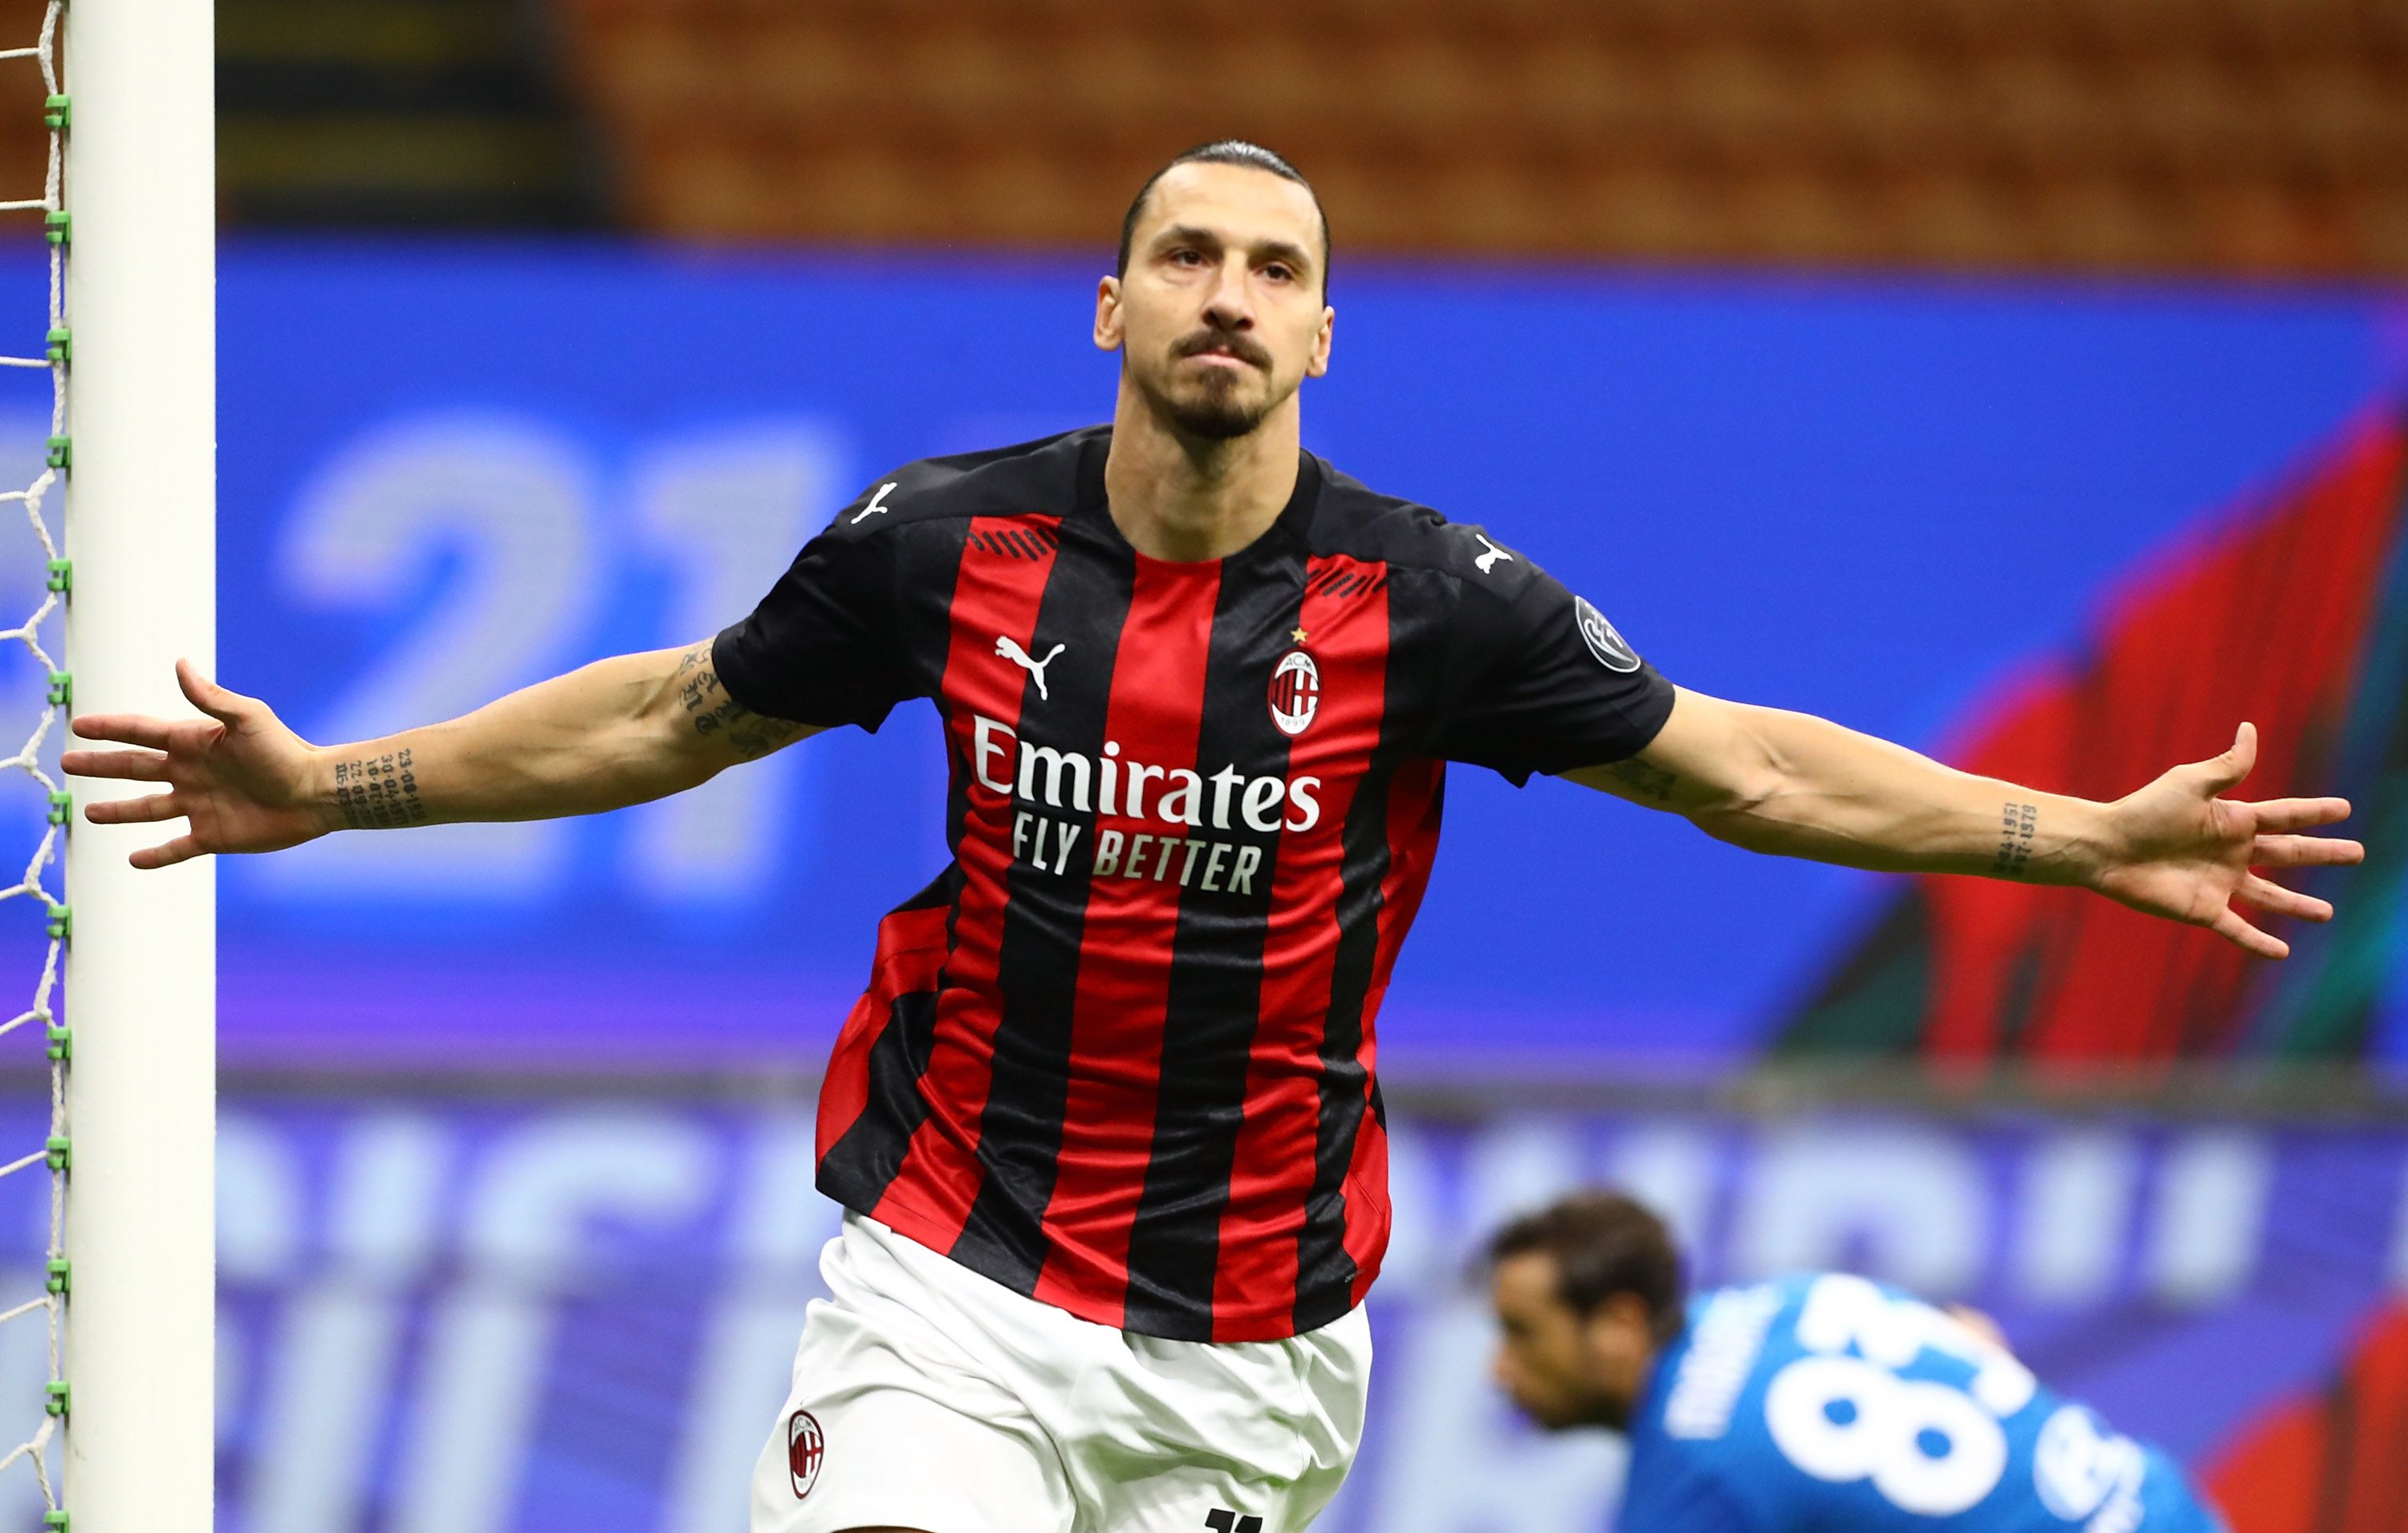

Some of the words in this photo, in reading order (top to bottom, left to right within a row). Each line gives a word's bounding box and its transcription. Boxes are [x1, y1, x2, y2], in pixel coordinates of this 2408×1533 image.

[974, 714, 1321, 832] Emirates
[1013, 810, 1081, 876] FLY
[1092, 829, 1263, 895] BETTER
[1764, 1273, 2037, 1517] 83
